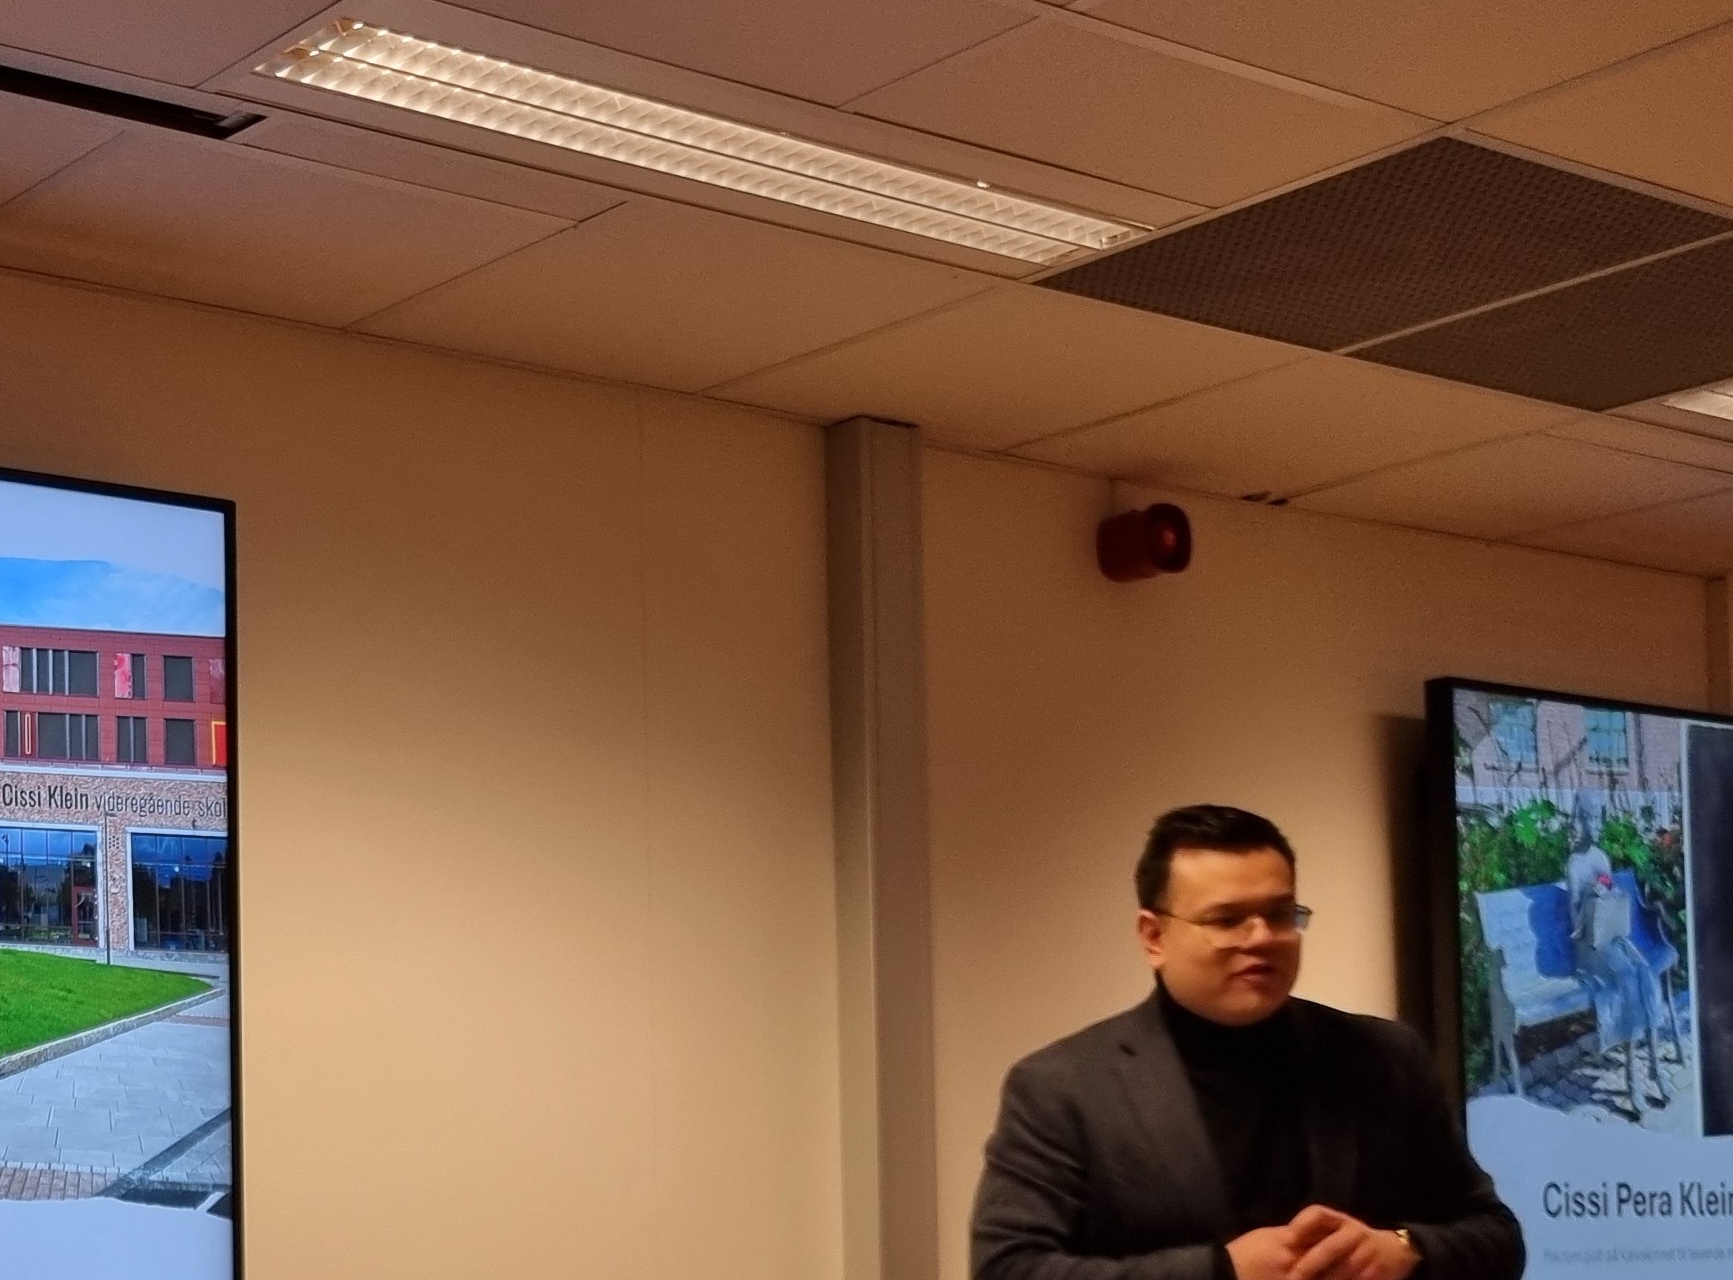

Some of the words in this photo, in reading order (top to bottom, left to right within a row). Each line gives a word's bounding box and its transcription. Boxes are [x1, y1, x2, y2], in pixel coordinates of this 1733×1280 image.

[2, 782, 42, 808] Cissi
[47, 785, 89, 810] Klein
[95, 791, 191, 817] videregående
[1542, 1181, 1609, 1219] Cissi
[1616, 1181, 1673, 1218] Pera
